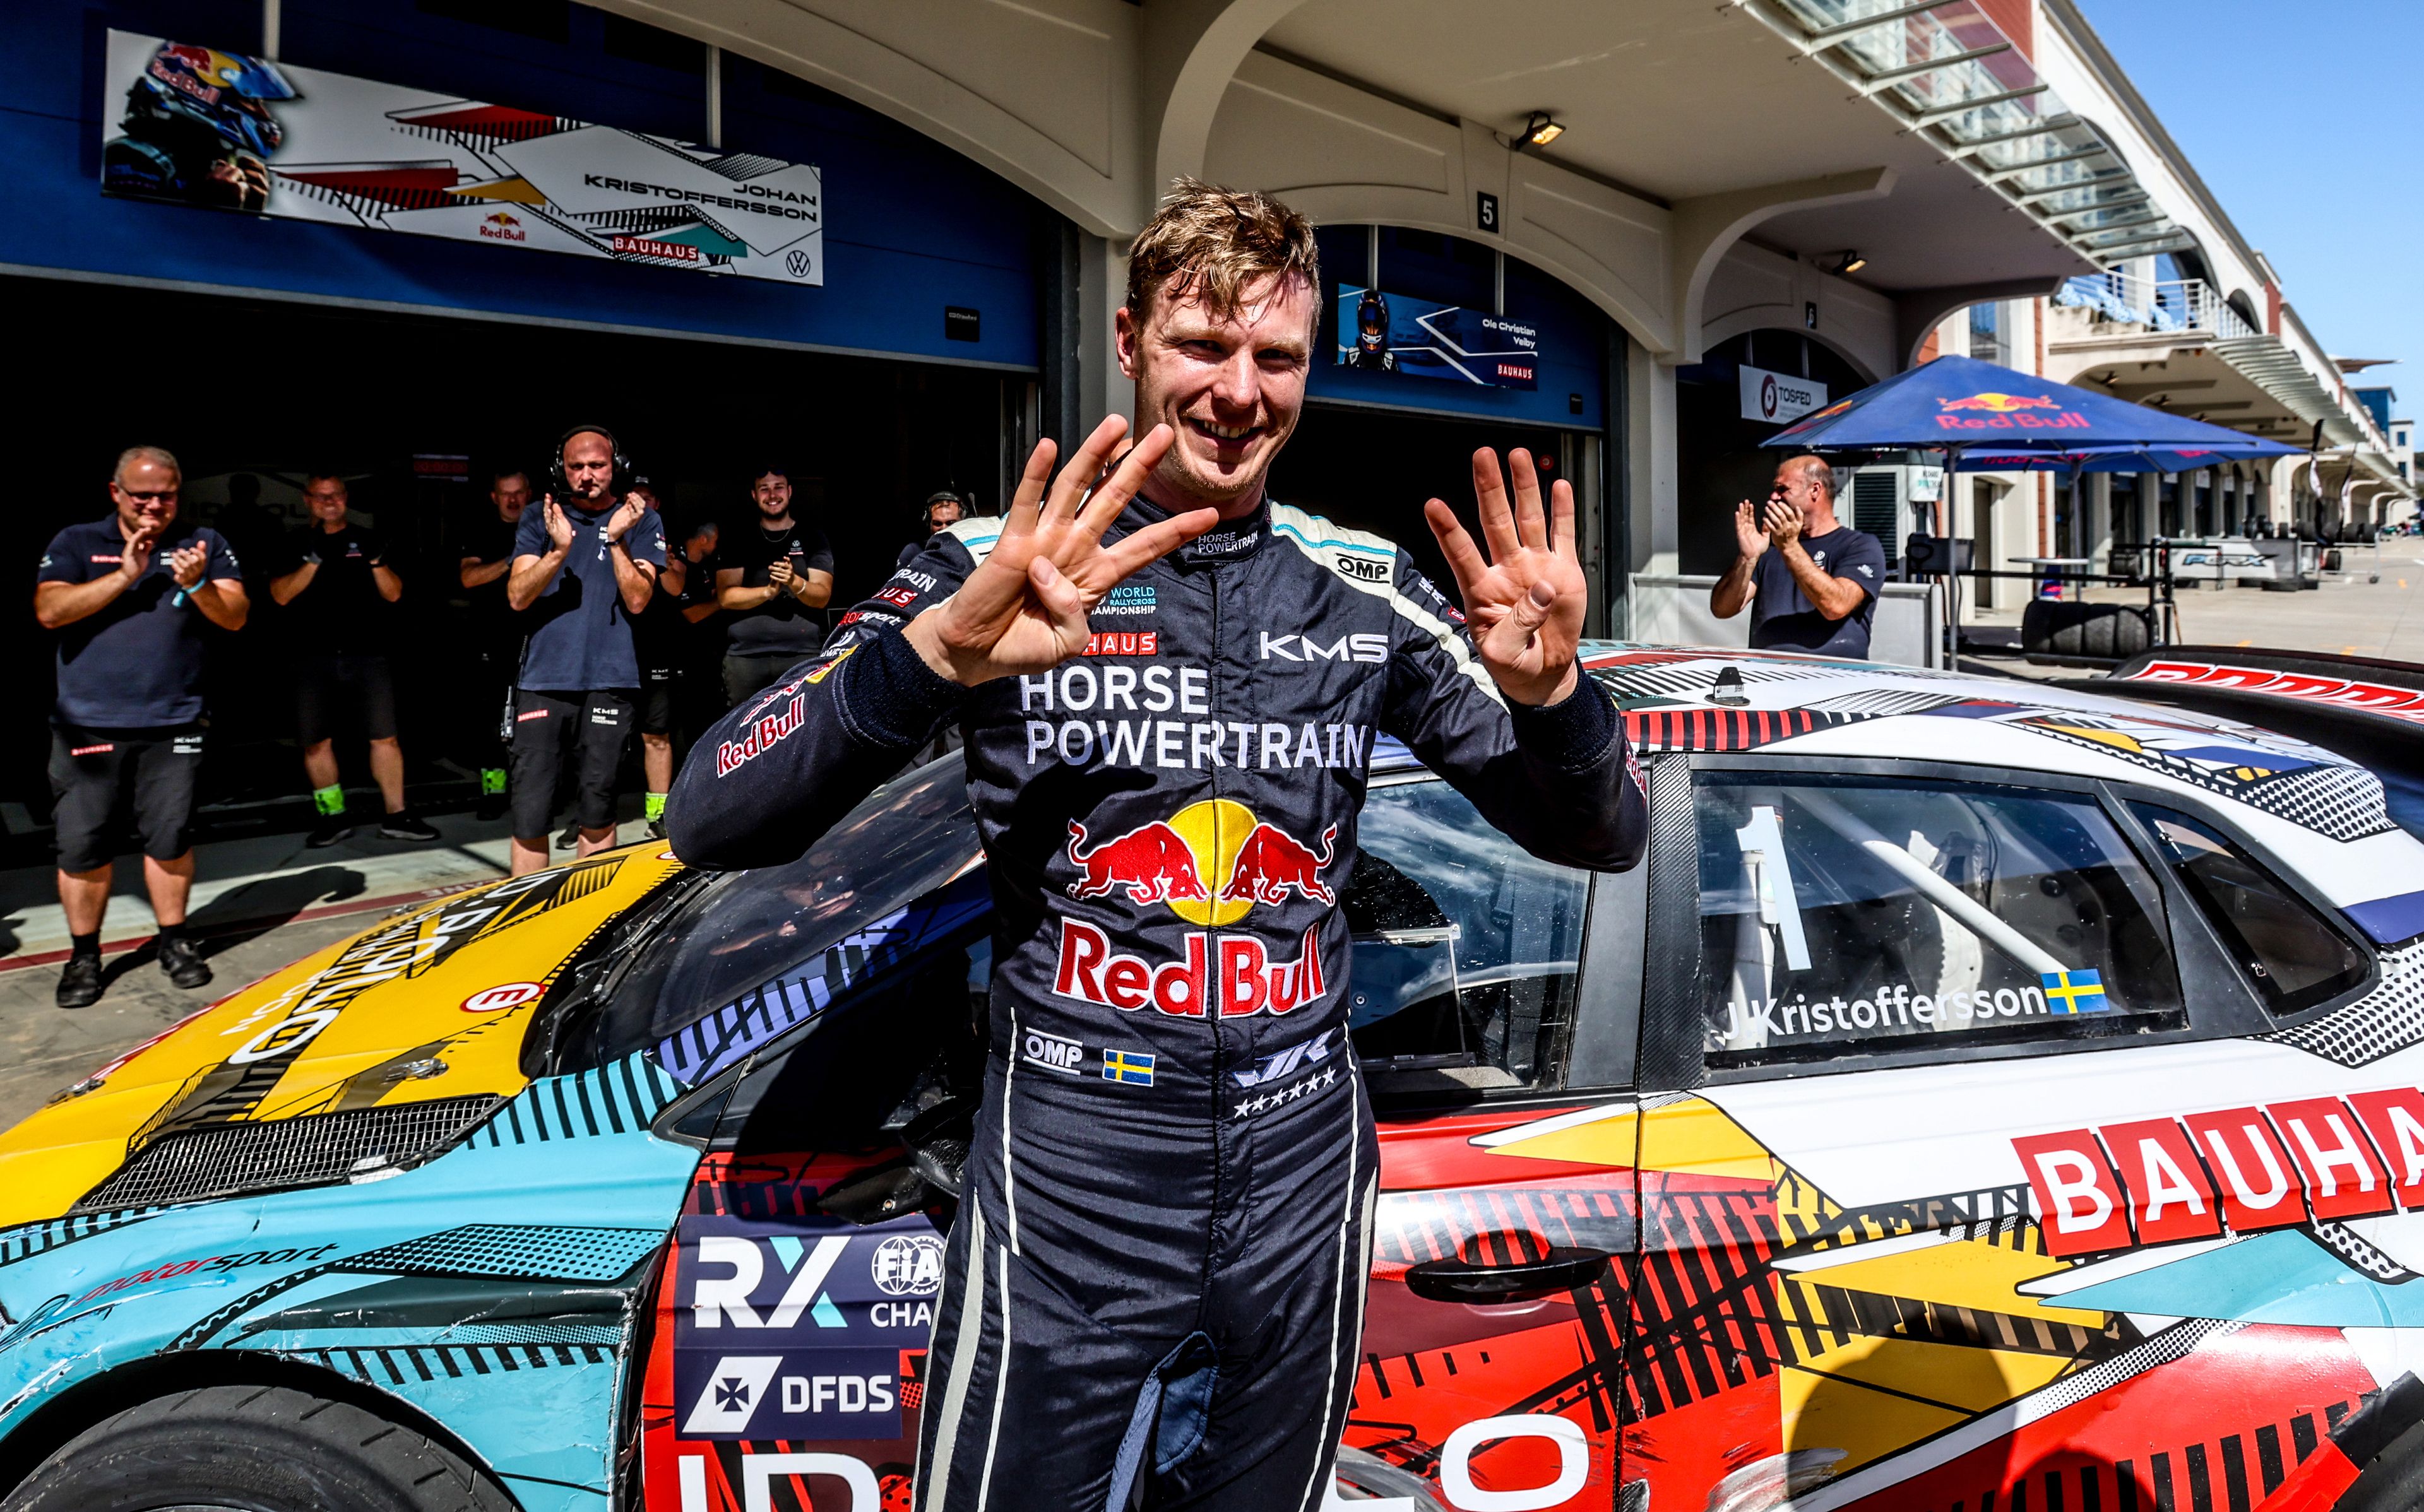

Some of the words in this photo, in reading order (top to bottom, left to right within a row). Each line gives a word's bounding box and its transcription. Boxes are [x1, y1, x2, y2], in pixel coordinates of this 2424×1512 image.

[152, 59, 182, 86] Red
[181, 75, 221, 106] Bull
[585, 174, 817, 222] KRISTOFFERSSON
[734, 184, 816, 206] JOHAN
[1483, 200, 1493, 225] 5
[480, 225, 501, 239] Red
[504, 229, 525, 241] Bull
[615, 237, 698, 260] BAUHAUS
[1483, 319, 1497, 329] Ole
[1499, 321, 1535, 336] Christian
[1513, 336, 1535, 349] Veiby
[1497, 364, 1533, 379] BAUHAUS
[1778, 387, 1811, 406] TOSFED
[1935, 413, 2014, 430] Red
[2017, 411, 2091, 429] Bull
[1197, 531, 1236, 544] HORSE
[1197, 530, 1258, 553] POWERTRAIN
[1337, 558, 1389, 579] OMP
[1110, 598, 1156, 606] RALLYCROSS
[1111, 586, 1155, 598] WORLD
[1091, 605, 1156, 615] AMPIONSHIP
[1084, 634, 1156, 653] HAUS
[1260, 631, 1389, 663] KMS
[1019, 665, 1211, 714] HORSE
[717, 721, 759, 779] Red
[758, 692, 805, 752] Bull
[1026, 719, 1370, 770] POWERTRAIN
[1736, 806, 1812, 971] 1
[1052, 916, 1208, 1019] Red
[1218, 921, 1327, 1020] Bull
[218, 965, 345, 1036] SOON
[1723, 1002, 1740, 1041] J
[1751, 984, 2048, 1037] Kristoffersson
[1025, 1033, 1083, 1070] OMP
[2033, 1106, 2424, 1234] BAUHA
[73, 1243, 340, 1306] motorsport
[694, 1236, 852, 1328] RX
[781, 1375, 894, 1414] DFDS
